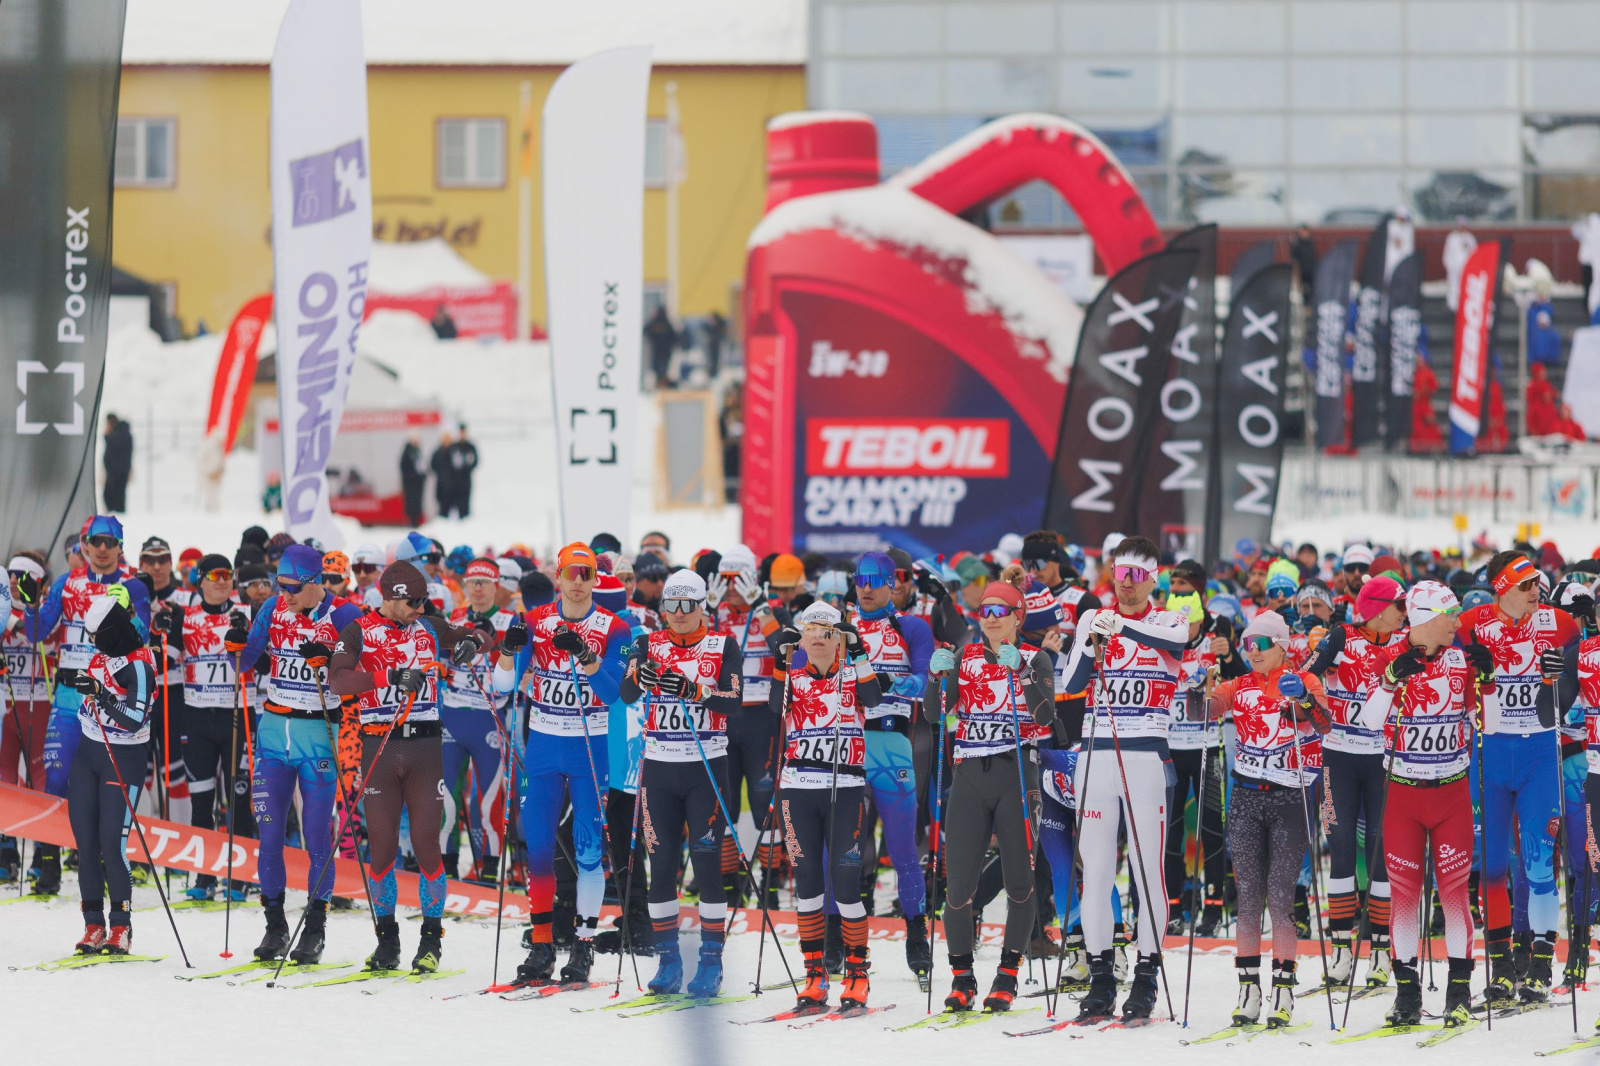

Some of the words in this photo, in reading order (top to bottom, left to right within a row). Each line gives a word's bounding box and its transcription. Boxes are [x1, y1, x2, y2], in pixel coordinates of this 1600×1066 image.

[58, 206, 90, 343] Ростех
[598, 282, 618, 390] Ростех
[1456, 270, 1488, 402] TEBOIL
[1160, 276, 1206, 490] MOAX
[288, 272, 338, 525] DEMINO
[1071, 292, 1160, 512] MOAX
[1234, 306, 1279, 515] MOAX
[820, 425, 996, 470] TEBOIL
[804, 476, 968, 502] DIAMOND
[804, 501, 917, 526] CARAT
[919, 501, 956, 527] III
[885, 633, 895, 643] 50
[207, 662, 228, 683] 71
[279, 657, 326, 682] 2664
[701, 663, 712, 673] 50
[1134, 671, 1165, 679] marathon
[382, 680, 430, 706] 262
[542, 679, 590, 709] 2665
[841, 692, 851, 703] 50
[1355, 692, 1368, 700] Dem
[1452, 680, 1462, 690] 50
[659, 695, 679, 703] Demin
[658, 705, 706, 730] 2667
[1413, 716, 1438, 724] Demino
[802, 729, 826, 737] Demino
[1406, 725, 1457, 753] 2666
[800, 738, 849, 763] 2676
[1322, 766, 1339, 826] ROMANOV
[641, 787, 660, 846] ROMANOV
[782, 800, 804, 858] ROMANOV
[1039, 818, 1066, 829] ntAuto
[1386, 852, 1420, 871] ЛУКОЙЛ
[1437, 850, 1467, 868] ФОСАГРО
[1441, 857, 1469, 874] BIVIUM
[1063, 982, 1092, 993] FISCHE
[1393, 1026, 1411, 1034] FISCHER
